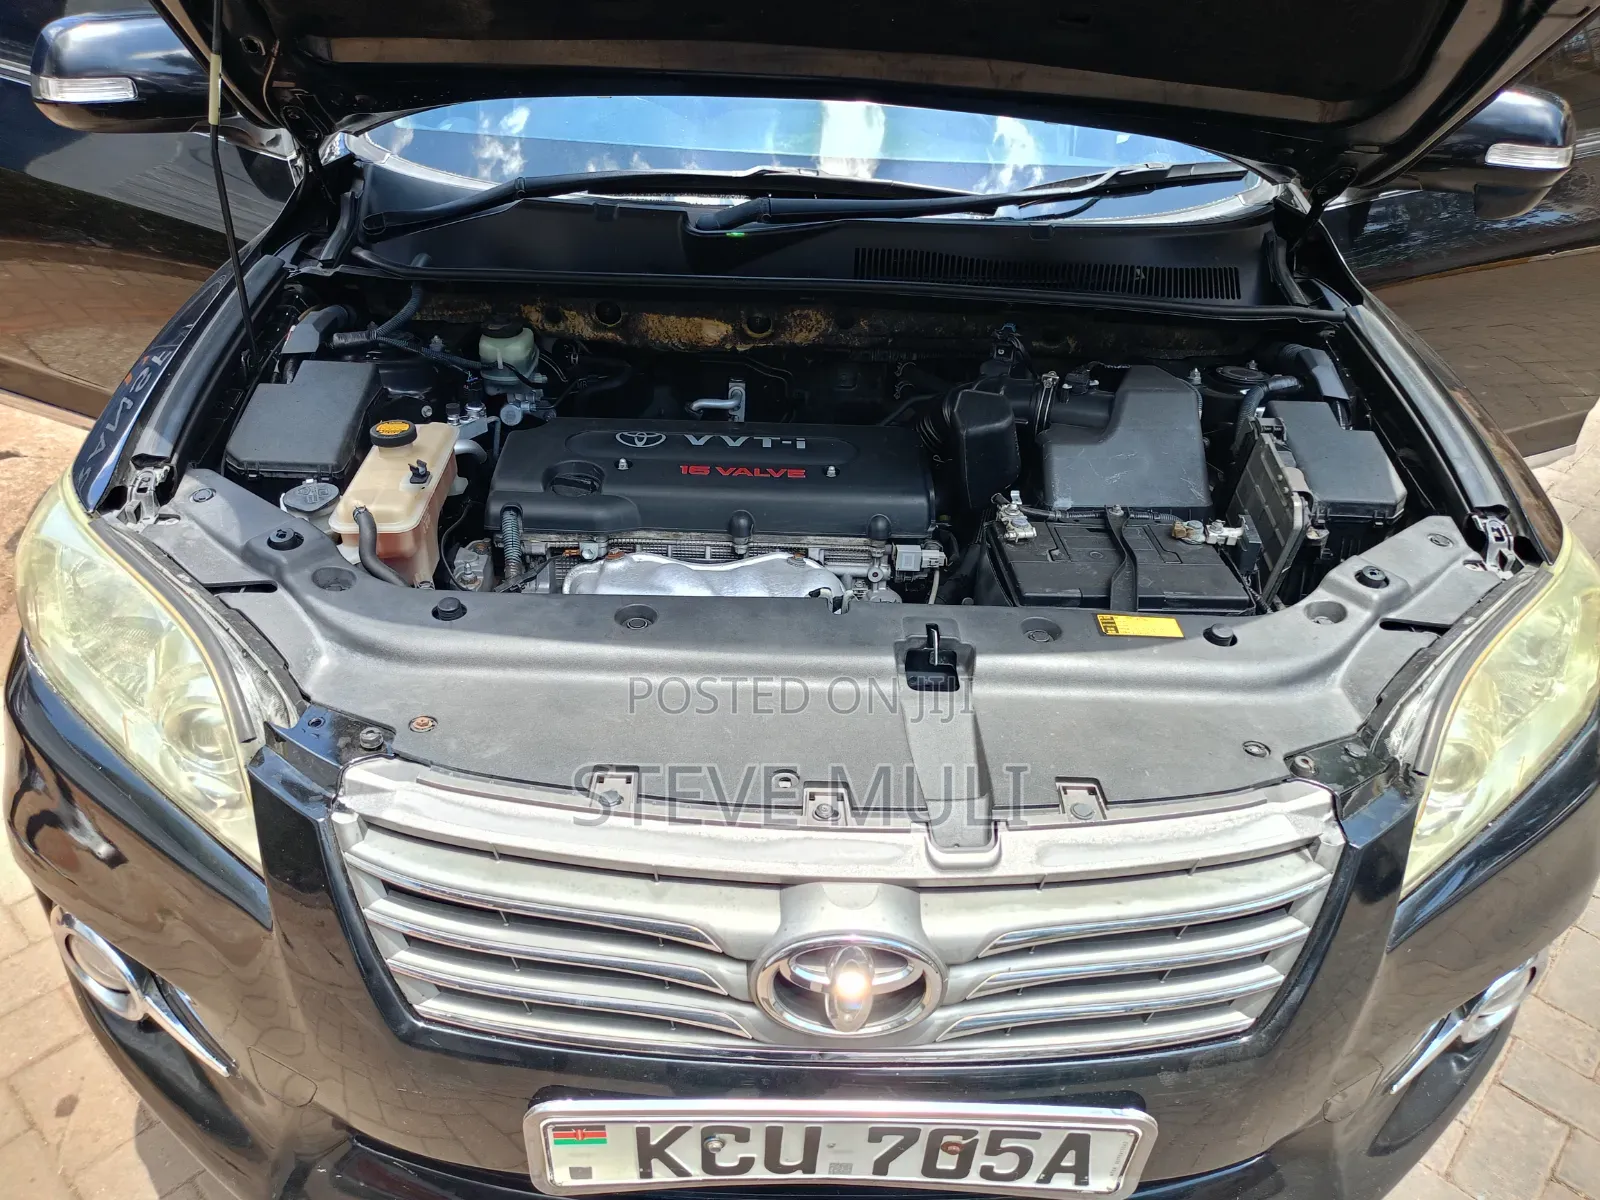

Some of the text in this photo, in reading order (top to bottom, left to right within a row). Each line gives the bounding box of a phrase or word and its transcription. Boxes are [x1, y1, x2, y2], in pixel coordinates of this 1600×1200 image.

[680, 465, 806, 478] 16 VALVE
[635, 1125, 823, 1179] KCU
[867, 1126, 1092, 1186] 705A
